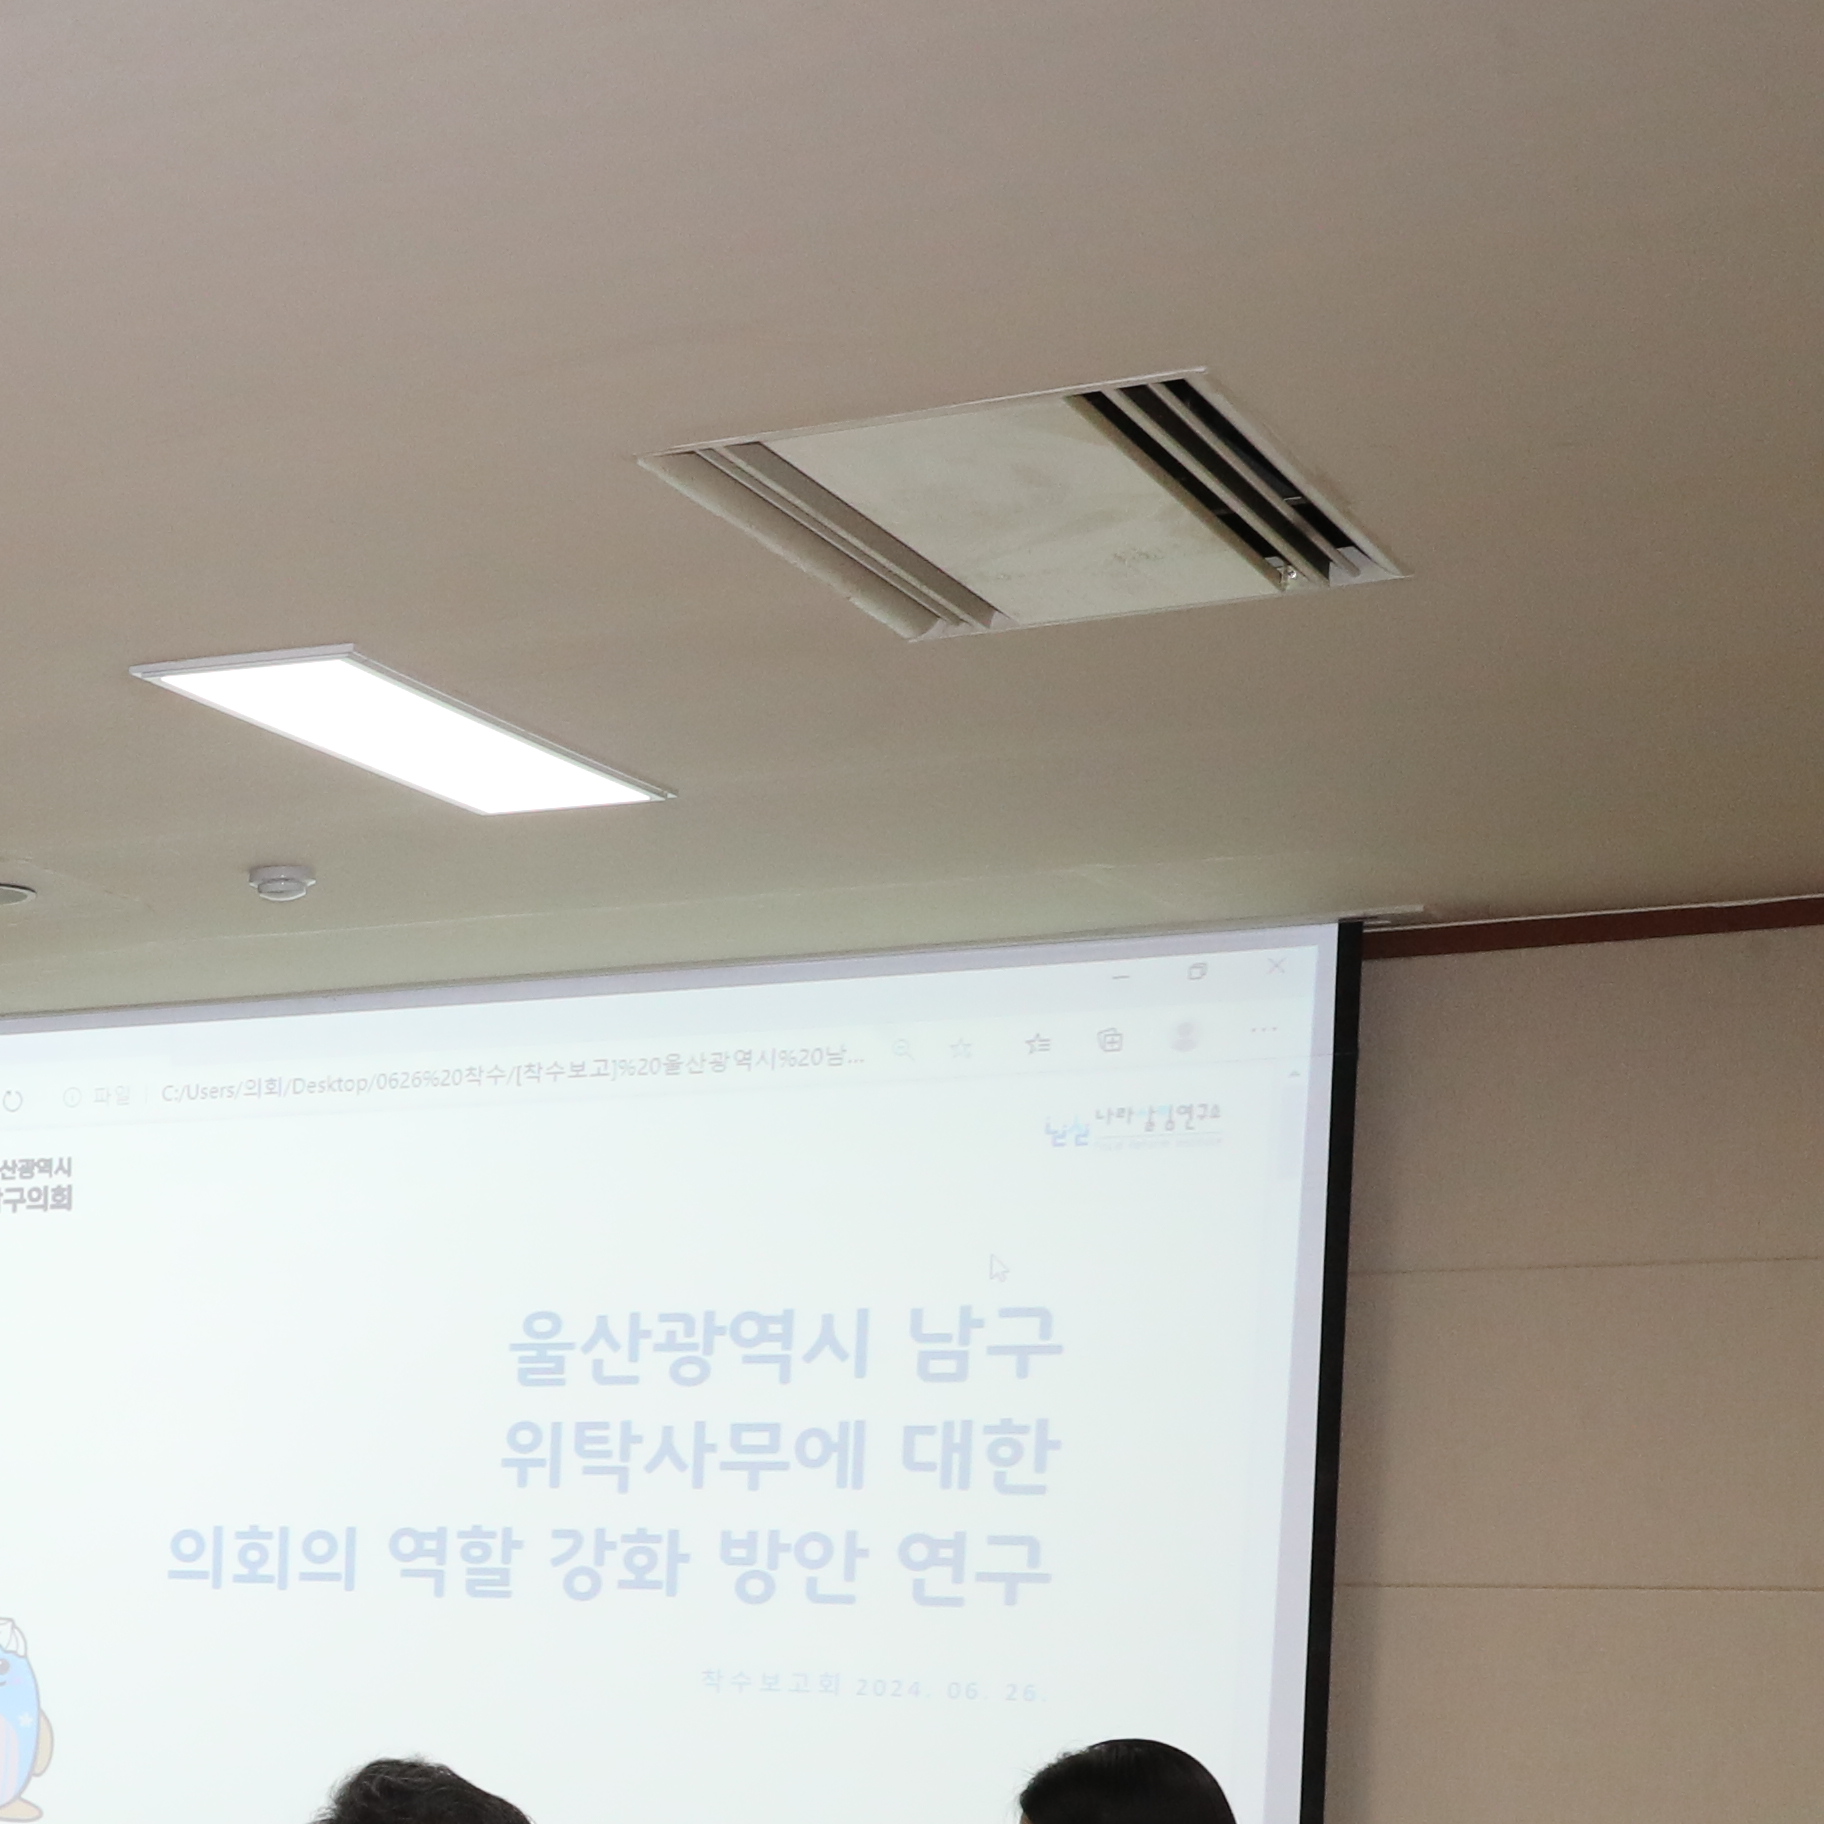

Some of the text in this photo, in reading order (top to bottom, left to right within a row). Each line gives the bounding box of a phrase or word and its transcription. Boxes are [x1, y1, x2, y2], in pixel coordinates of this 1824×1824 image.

[508, 1304, 1064, 1387] 울산광역시 남구
[501, 1417, 1062, 1496] 위탁사무에 대한
[167, 1524, 1053, 1609] 의회의 역할 강화 방안 연구
[700, 1667, 842, 1697] 착수보고회
[855, 1676, 932, 1699] 2024.
[1004, 1683, 1050, 1703] 26.
